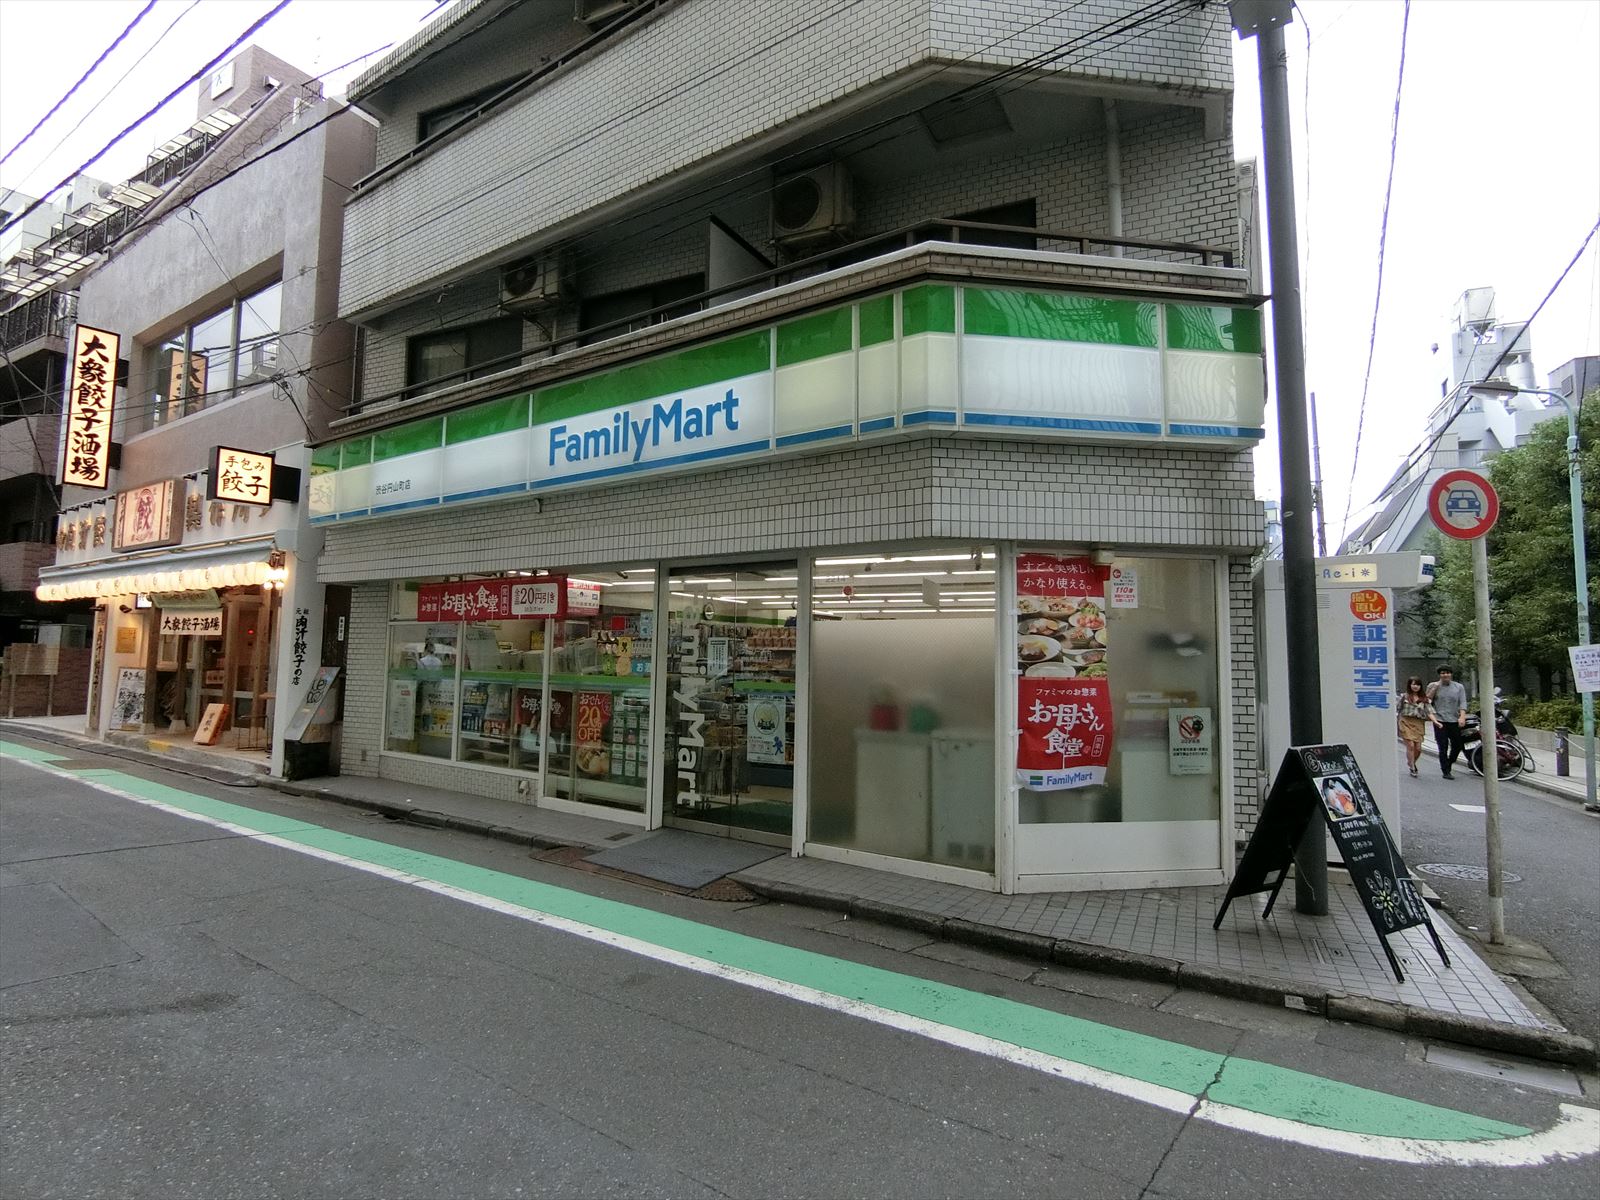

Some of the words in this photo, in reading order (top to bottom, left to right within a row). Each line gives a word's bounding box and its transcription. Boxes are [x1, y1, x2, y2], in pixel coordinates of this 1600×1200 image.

[69, 334, 110, 482] 大衆餃子酒場
[549, 388, 739, 467] FamilyMart
[225, 455, 266, 472] 手包み
[220, 468, 269, 497] 餃子
[1023, 577, 1092, 591] かなり使える。
[441, 585, 499, 617] お母さん食堂
[162, 616, 221, 631] 大衆餃子酒場
[291, 615, 308, 686] 肉汁餃子の店
[1351, 624, 1390, 710] 証明写真
[1036, 687, 1097, 697] ファミマのお惣菜
[1027, 698, 1104, 732] お母さん
[578, 727, 601, 742] OFF
[1042, 727, 1084, 757] 食堂
[1046, 771, 1093, 785] FamilyMart
